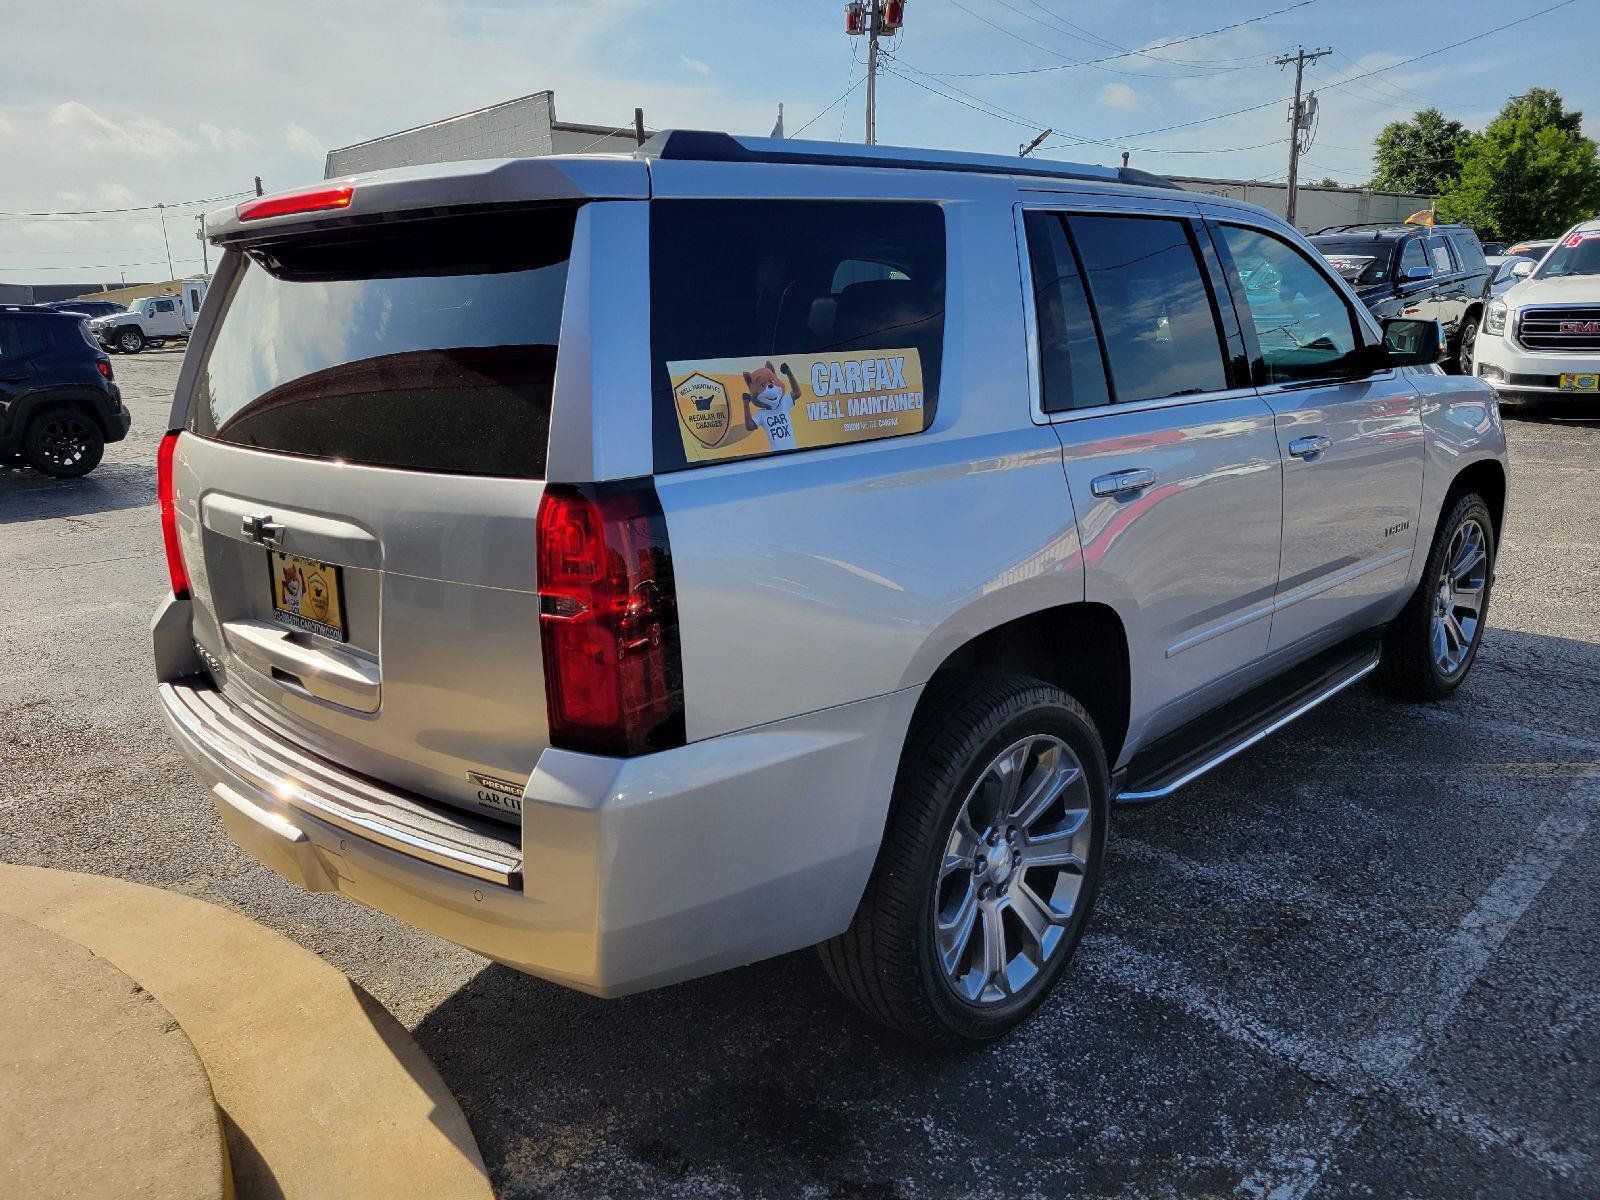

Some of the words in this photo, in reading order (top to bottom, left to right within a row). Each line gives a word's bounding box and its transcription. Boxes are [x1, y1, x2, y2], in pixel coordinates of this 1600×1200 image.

[811, 357, 907, 398] CARFAX
[807, 400, 845, 422] WELL
[847, 392, 923, 417] MAINTAINED
[688, 413, 715, 423] REGULAR
[716, 411, 726, 420] OIL
[766, 413, 788, 427] CAR
[695, 420, 722, 430] CHANGES
[843, 422, 860, 432] SHOW
[769, 426, 791, 441] FOX
[482, 779, 523, 797] PREMIER
[477, 790, 501, 805] CAR
[503, 796, 522, 811] CIT
